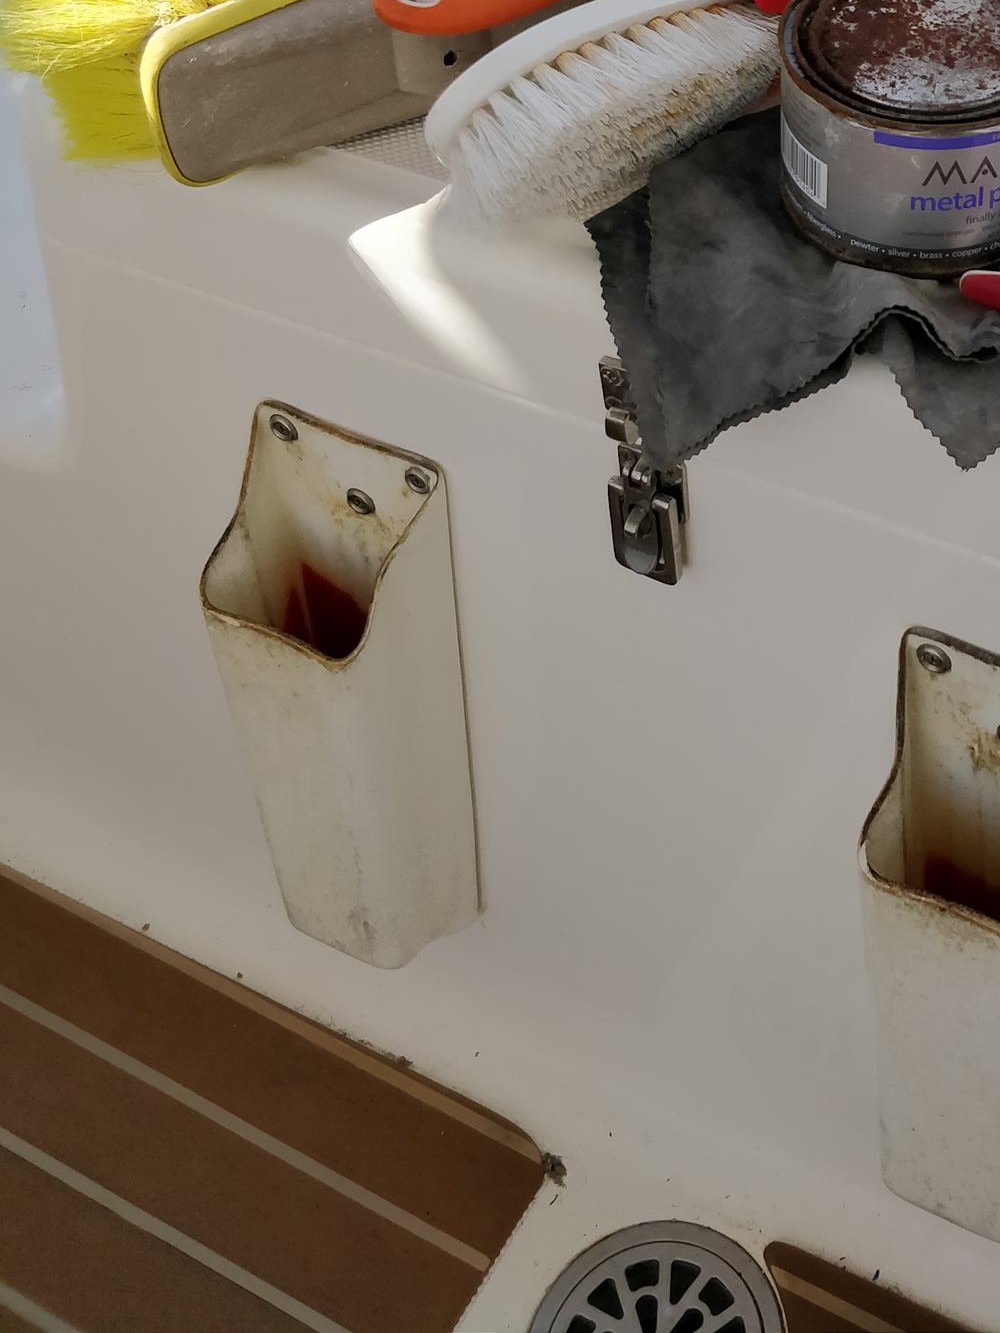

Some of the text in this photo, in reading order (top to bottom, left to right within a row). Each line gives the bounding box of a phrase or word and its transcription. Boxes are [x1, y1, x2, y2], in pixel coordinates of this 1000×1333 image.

[910, 186, 984, 212] metal
[850, 239, 879, 253] pewter
[888, 248, 910, 259] silver
[919, 250, 943, 259] brass
[951, 246, 982, 259] copper
